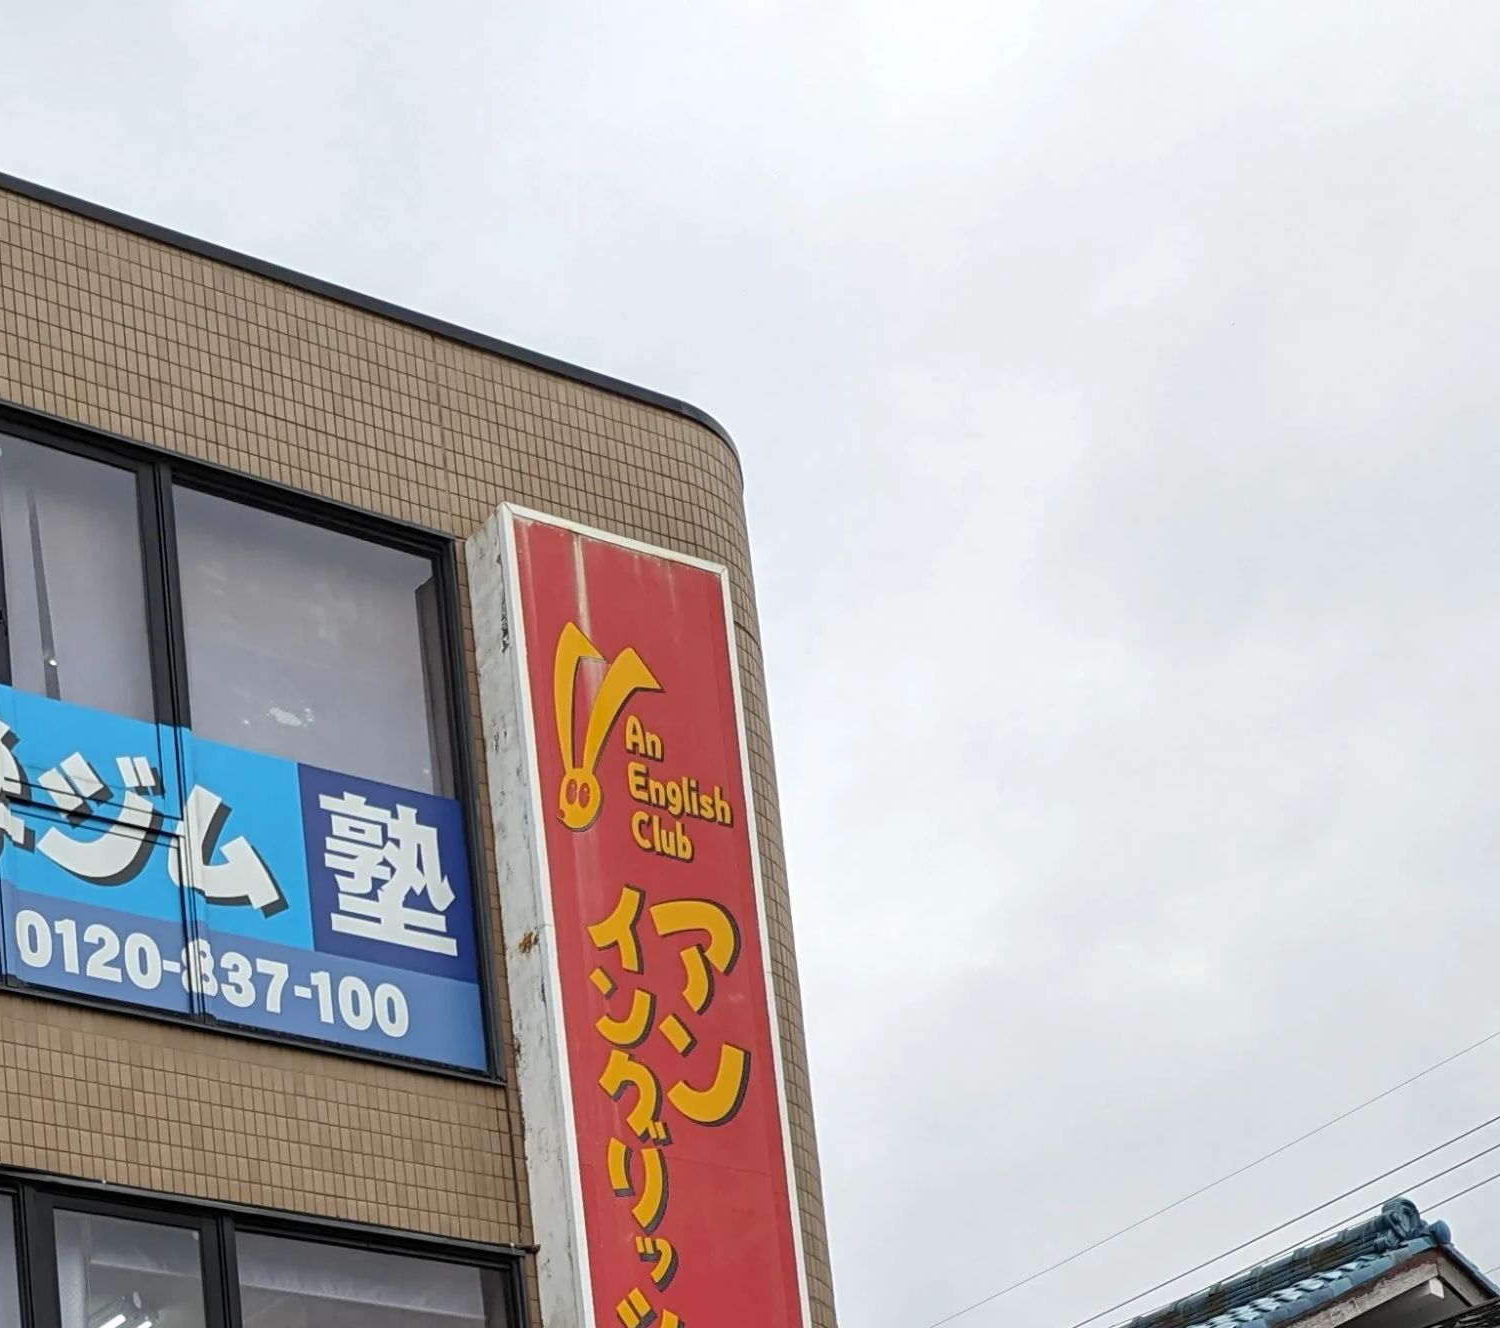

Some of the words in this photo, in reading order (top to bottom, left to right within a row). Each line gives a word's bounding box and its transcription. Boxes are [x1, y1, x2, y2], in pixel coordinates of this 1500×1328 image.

[625, 714, 665, 762] An
[627, 761, 735, 828] English
[630, 809, 695, 863] Club
[316, 790, 459, 957] 塾
[15, 908, 411, 1039] 0120-837-100
[649, 897, 751, 1127] アン
